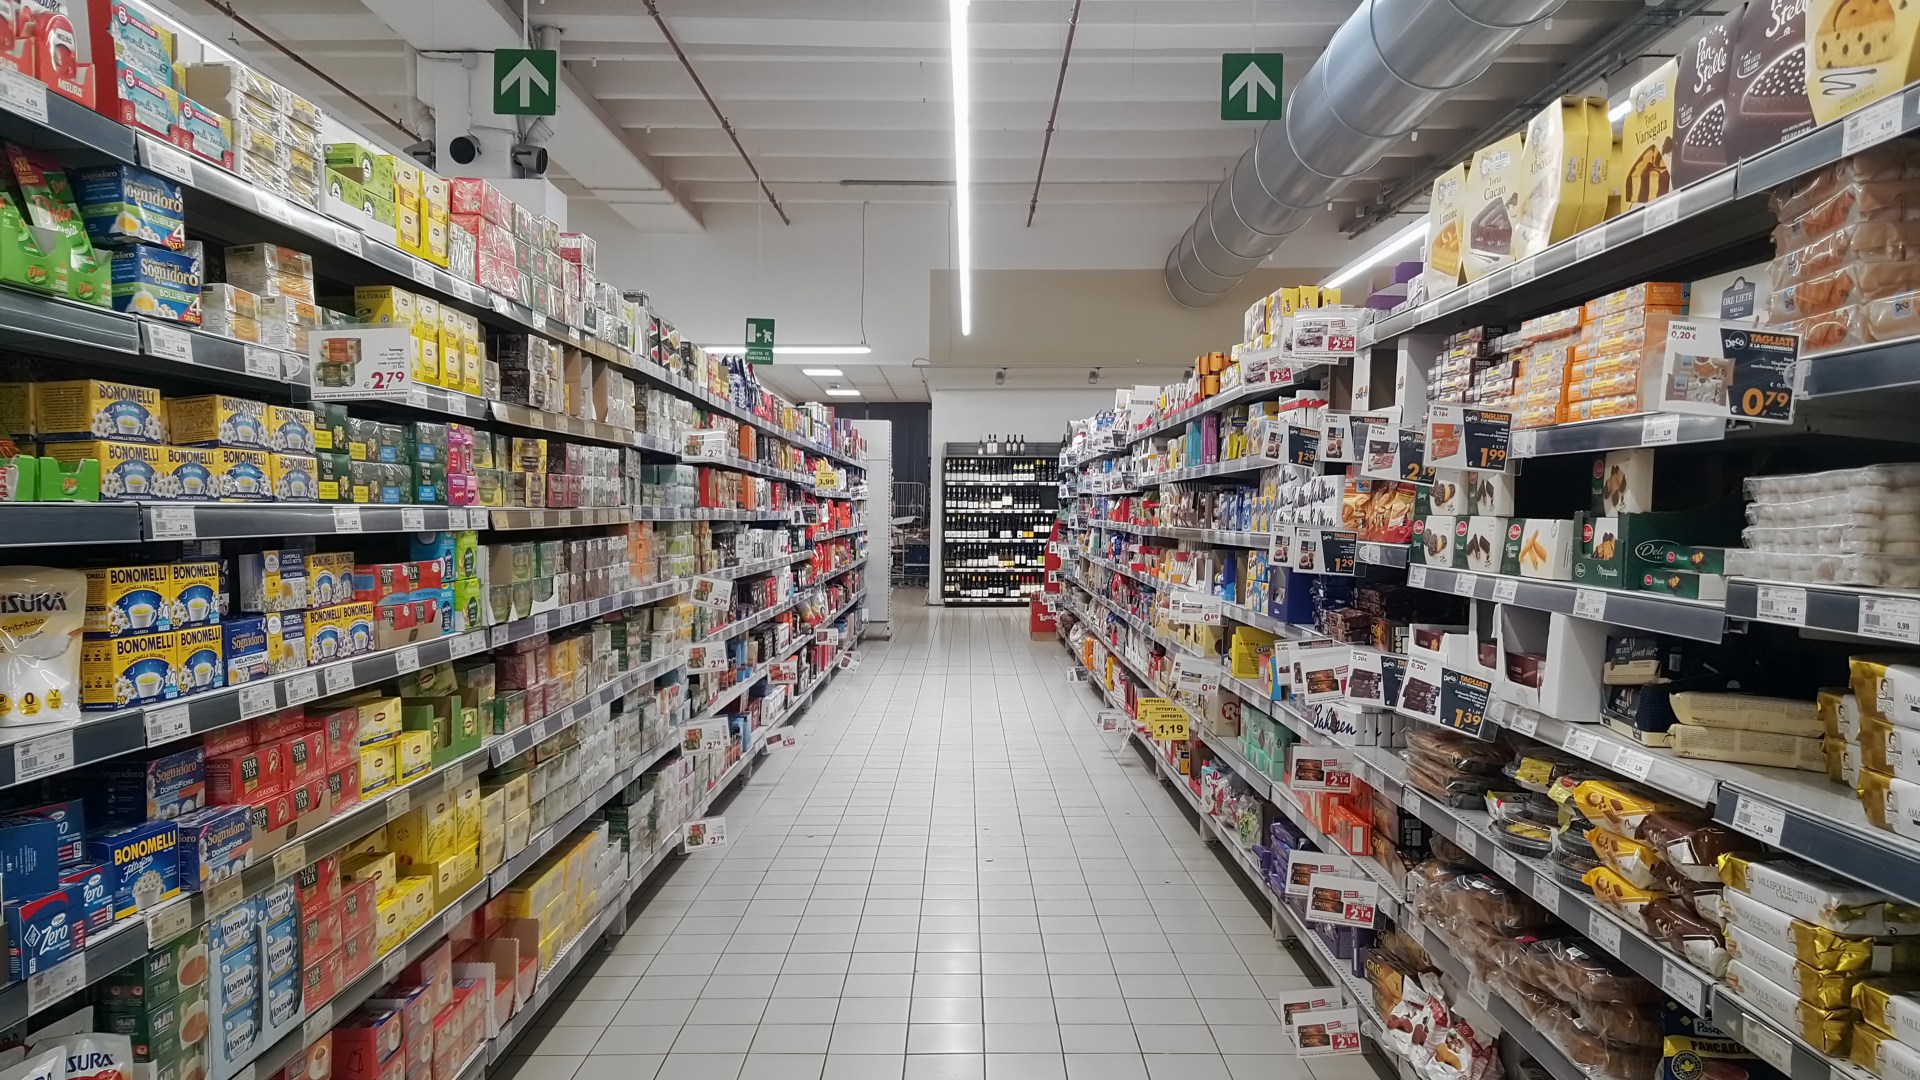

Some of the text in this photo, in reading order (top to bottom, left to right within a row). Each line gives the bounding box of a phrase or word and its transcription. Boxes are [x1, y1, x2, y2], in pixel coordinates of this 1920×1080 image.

[131, 18, 157, 37] POMPADOUR
[1696, 37, 1712, 69] Pan
[1694, 47, 1728, 93] Stelle
[57, 78, 83, 98] MISURA
[138, 80, 164, 98] POMPADOUR
[195, 111, 218, 128] POMPADOUR
[1635, 119, 1668, 146] Variegata
[1488, 176, 1502, 187] Torta
[1484, 184, 1506, 201] Cacao
[143, 211, 176, 228] SOLUBILE
[1439, 209, 1458, 225] Limone
[173, 224, 184, 241] 4
[141, 257, 199, 287] Sognid'oro
[159, 289, 192, 302] SOLUBILE
[1722, 291, 1753, 306] ORE LIETE
[190, 296, 202, 316] 4
[1671, 331, 1691, 340] 0,20
[1672, 324, 1697, 332] RISPARMI
[1333, 340, 1353, 350] 2,54
[1750, 333, 1795, 347] TAGLIATI
[371, 371, 405, 390] 2,79
[1274, 373, 1290, 382] 2,54
[100, 384, 154, 404] BONOMELLI
[1742, 387, 1789, 417] 0,79
[1481, 412, 1509, 421] TAGLIATI
[109, 446, 159, 462] BONOMELLI
[169, 450, 214, 465] BONOMELLI
[224, 450, 266, 466] BONOMELLI
[1480, 447, 1506, 468] 1,99
[280, 459, 314, 471] BONOMELLI
[818, 478, 835, 486] 3,99
[174, 564, 217, 579] BONOMELLI
[1335, 557, 1354, 572] 1,29
[110, 567, 167, 584] BONOMELLI
[310, 608, 342, 623] BONOMELLI
[343, 605, 373, 618] BONOMELLI
[2, 618, 44, 633] Eritritolo
[1897, 621, 1910, 630] 0,99
[181, 627, 221, 646] BONOMELLI
[117, 635, 174, 655] BONOMELLI
[234, 655, 263, 664] MELATONINA
[1460, 675, 1489, 689] TAGLIATI
[329, 720, 341, 731] STAR
[1454, 708, 1482, 728] 1,39
[330, 730, 341, 739] TEA
[1159, 724, 1184, 735] 1,19
[292, 742, 306, 755] STAR
[242, 759, 257, 771] STAR
[294, 752, 307, 763] TEA
[156, 761, 197, 784] Sognid'oro
[245, 768, 257, 778] TEA
[1330, 775, 1350, 787] 2,14
[256, 783, 280, 798] CLASSICO
[295, 791, 308, 802] STAR
[297, 800, 309, 809] TEA
[207, 821, 245, 846] Sognid'oro
[114, 830, 177, 866] BONOMELLI
[299, 864, 317, 877] STAR
[301, 874, 317, 887] TEA
[1350, 908, 1372, 921] 2,14
[39, 923, 69, 955] Zero
[1337, 1037, 1358, 1049] 2,14
